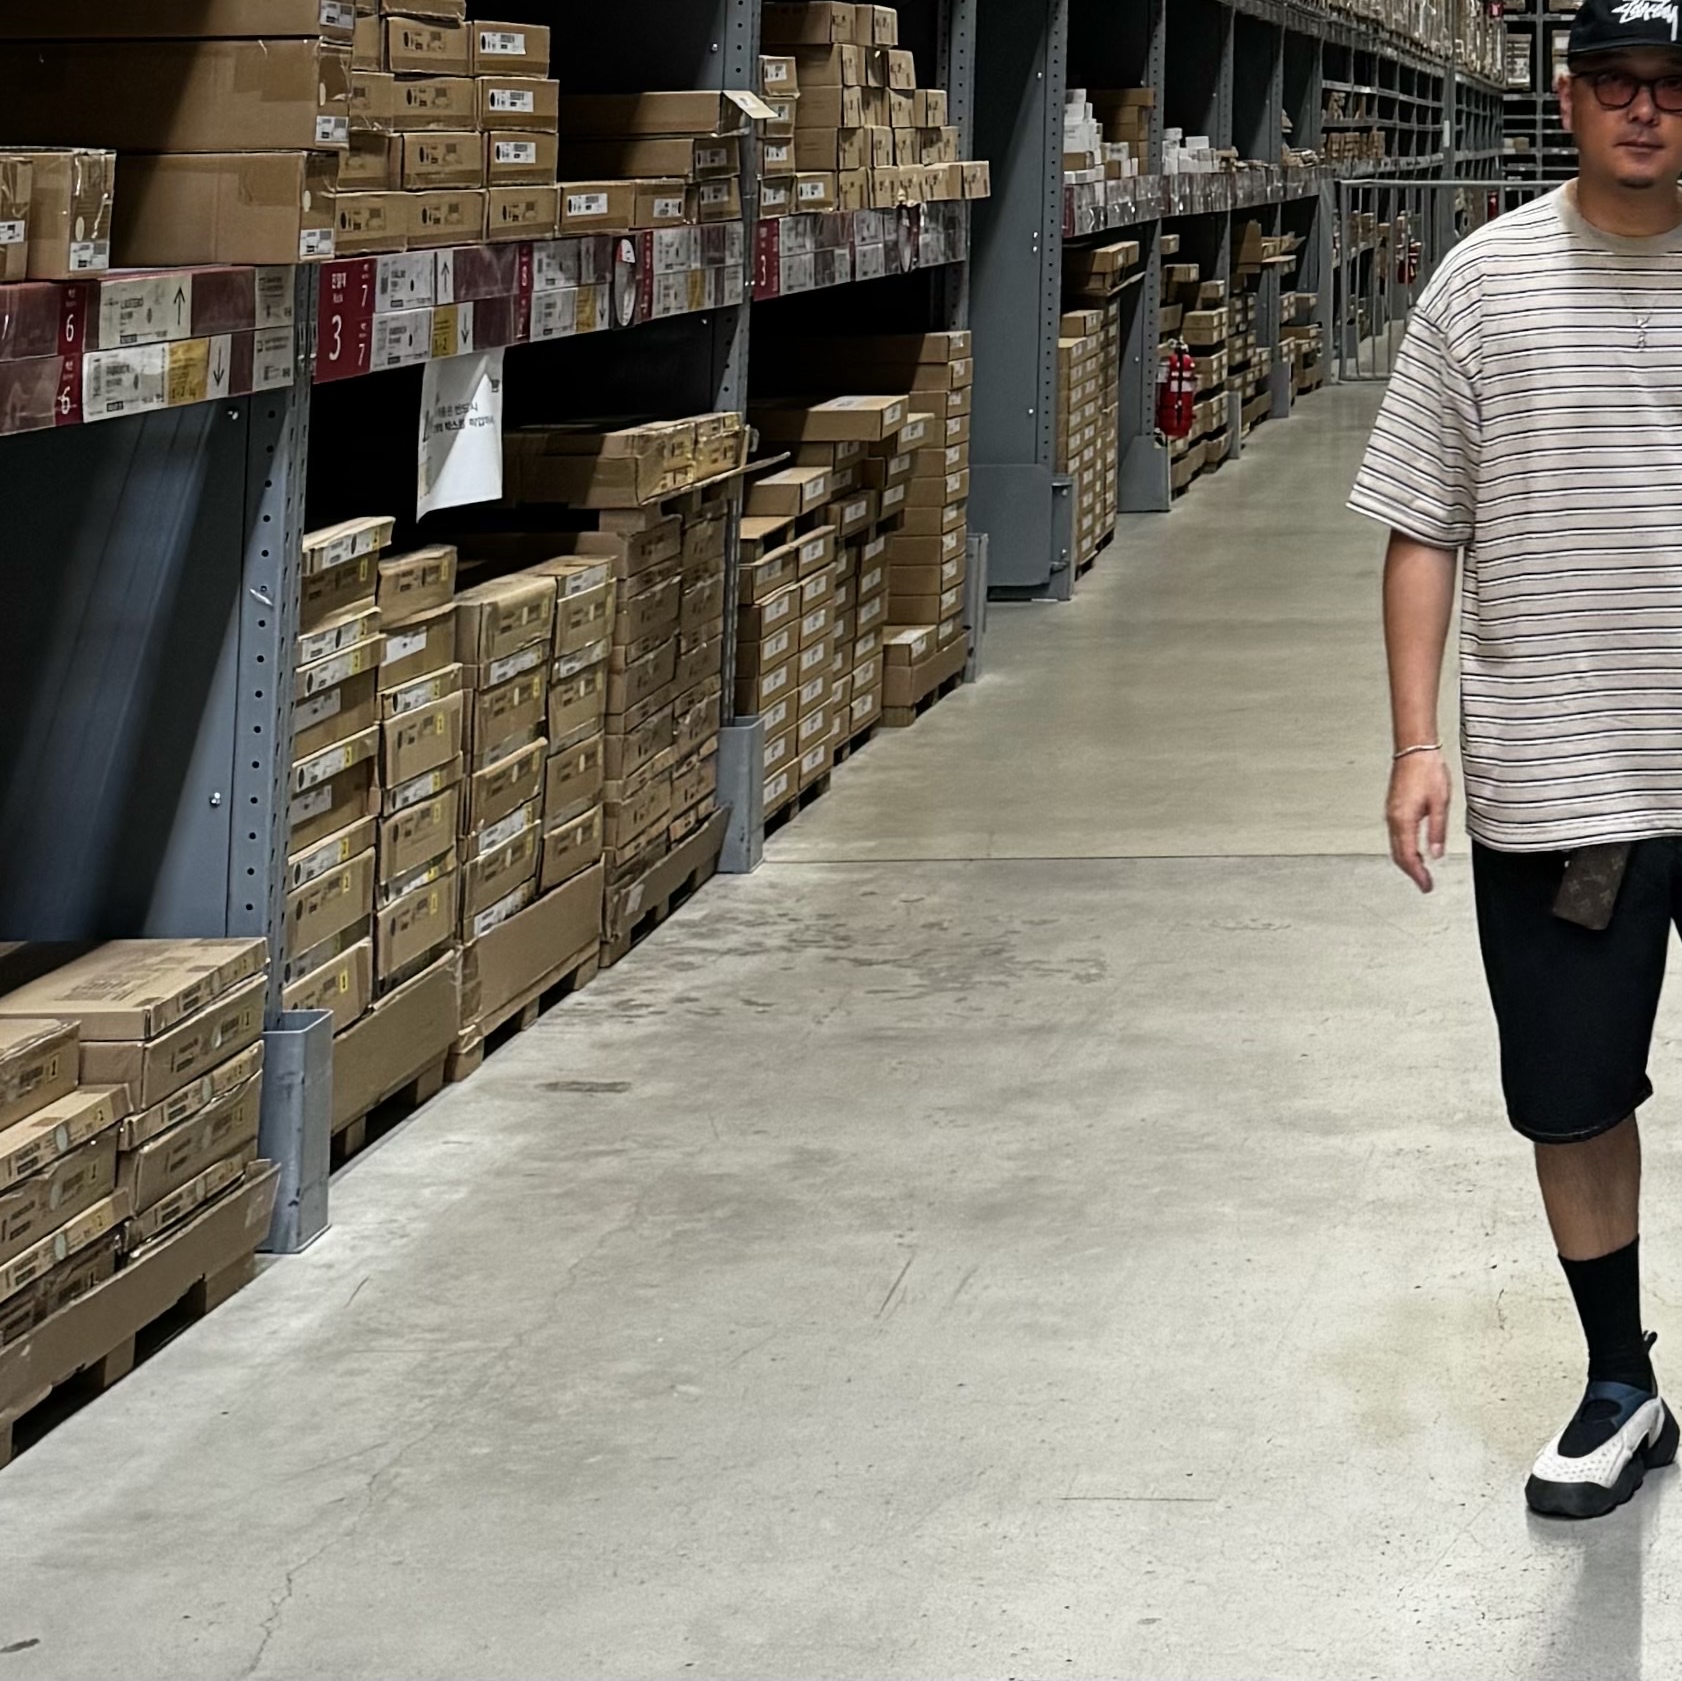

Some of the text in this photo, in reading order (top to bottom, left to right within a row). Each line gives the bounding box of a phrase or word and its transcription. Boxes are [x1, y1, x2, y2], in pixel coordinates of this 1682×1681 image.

[361, 284, 368, 308] 7
[66, 313, 75, 343] 6
[329, 314, 342, 361] 3
[358, 343, 366, 366] 7
